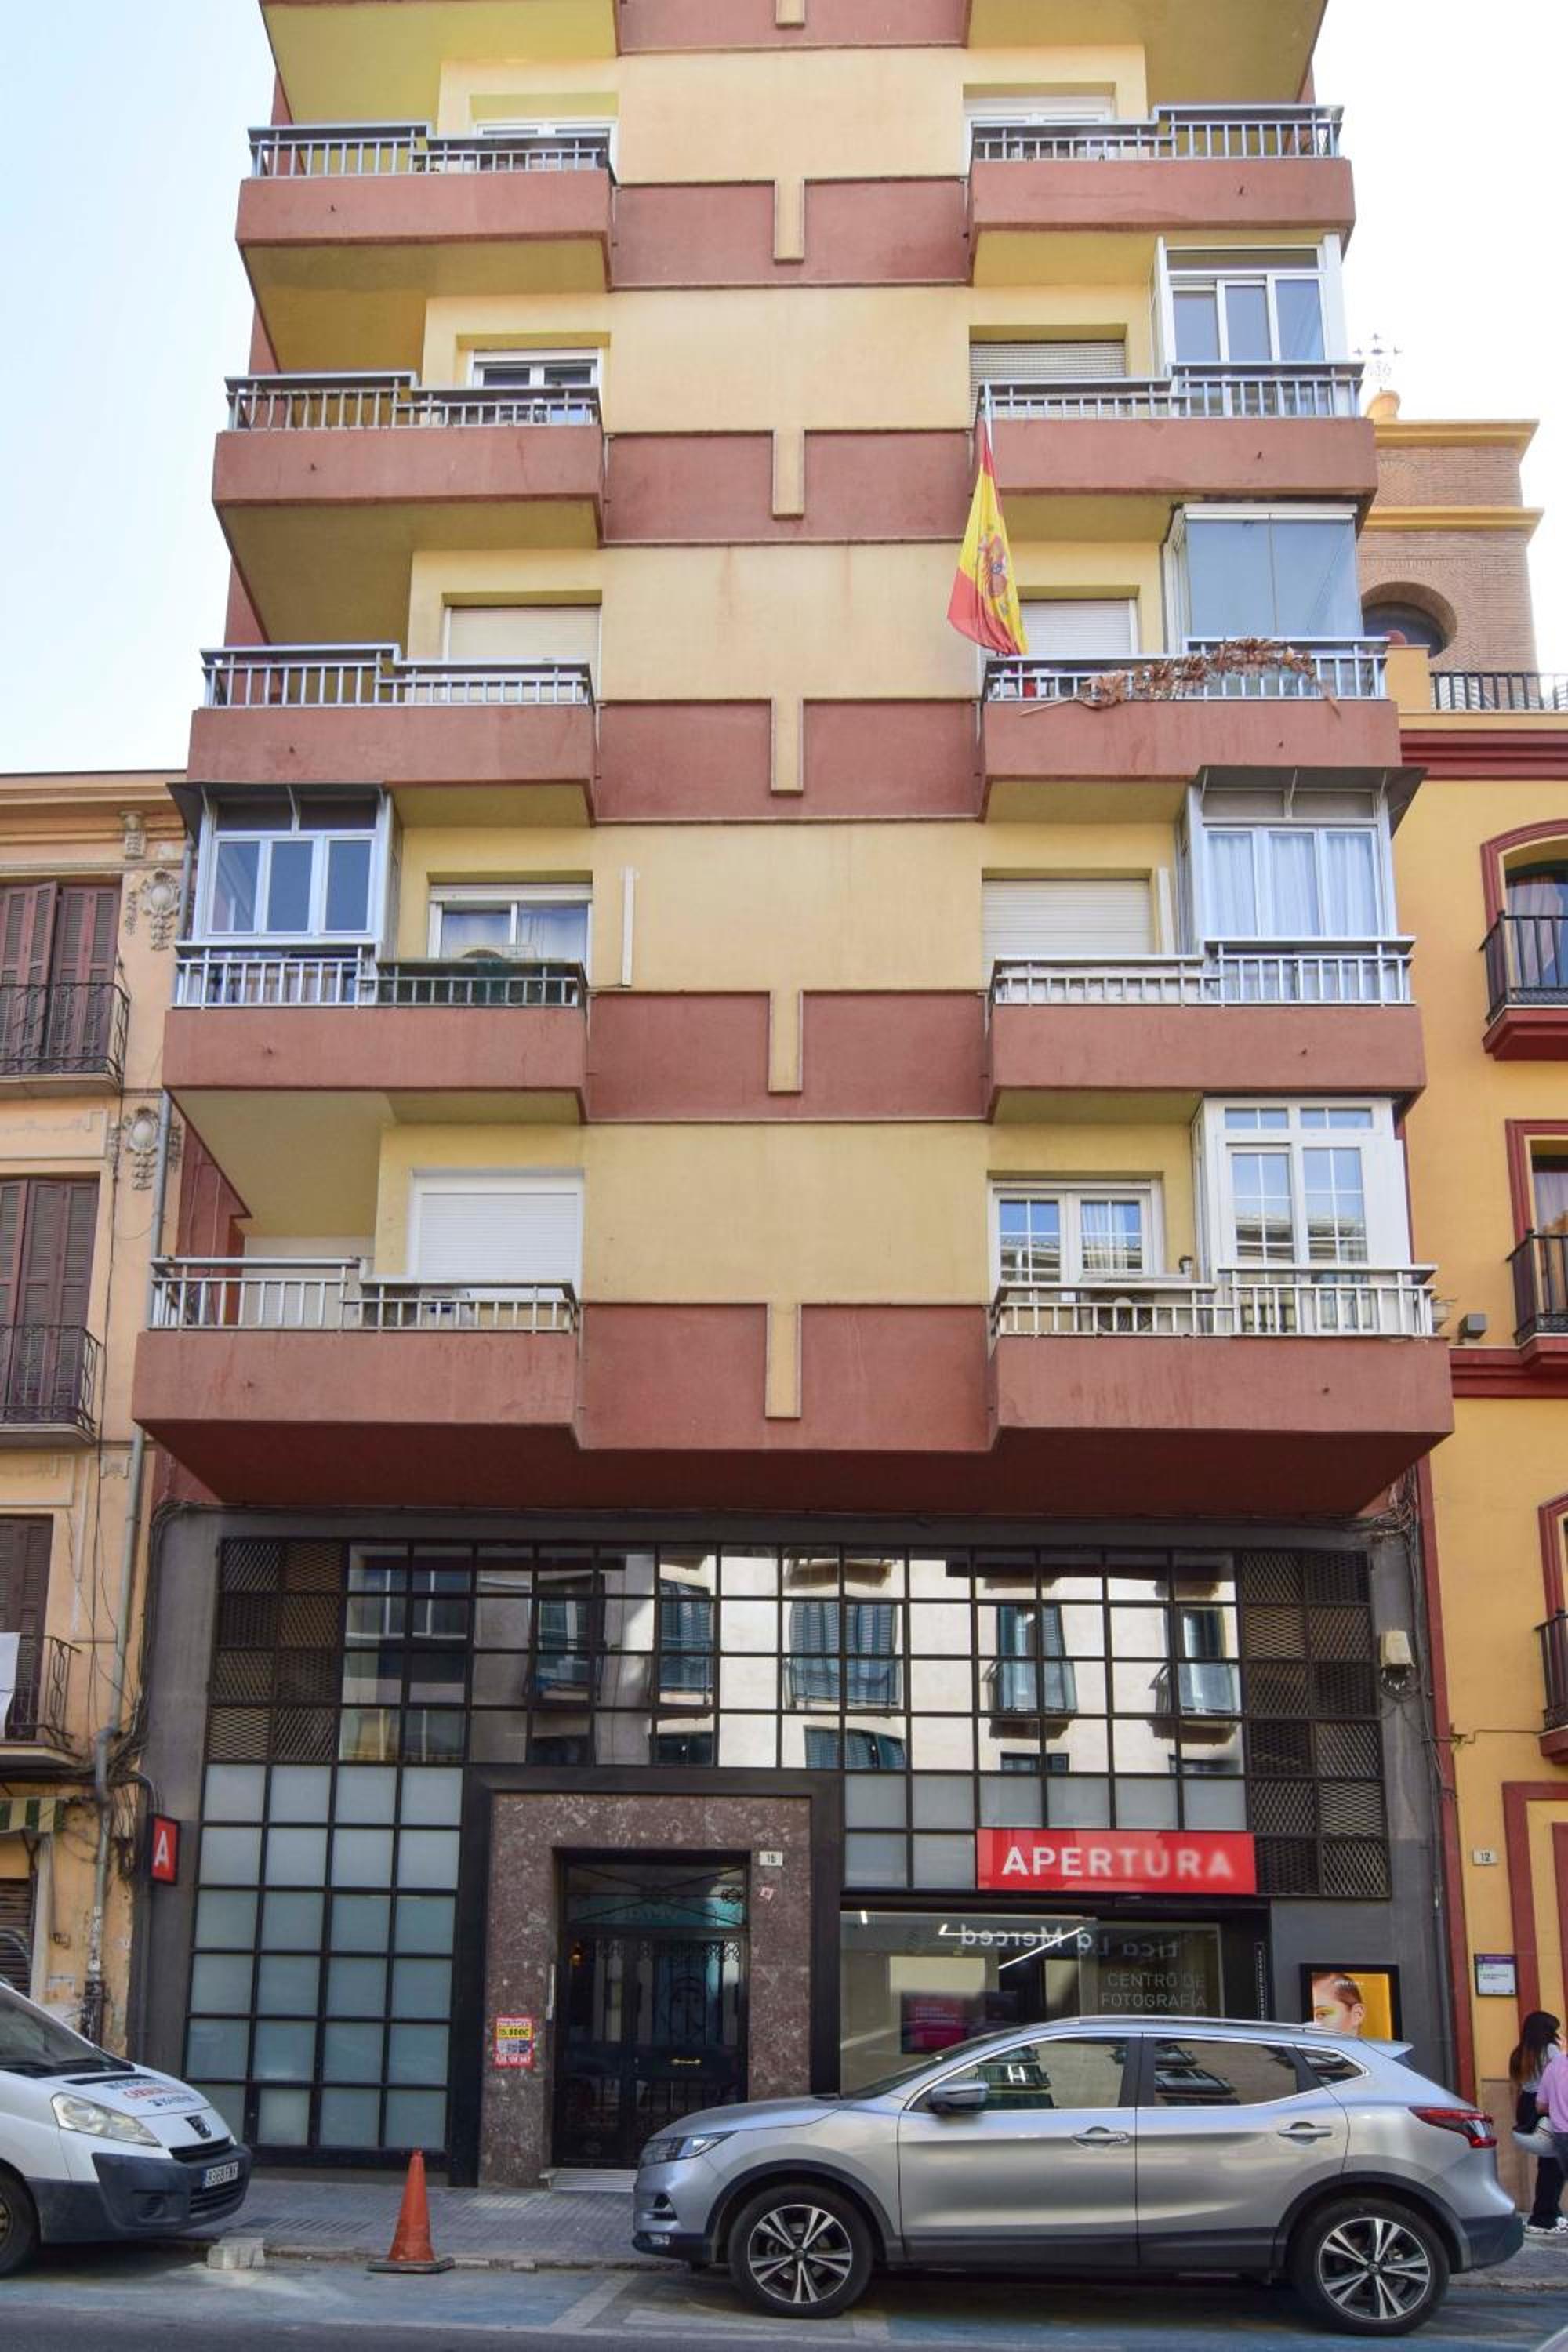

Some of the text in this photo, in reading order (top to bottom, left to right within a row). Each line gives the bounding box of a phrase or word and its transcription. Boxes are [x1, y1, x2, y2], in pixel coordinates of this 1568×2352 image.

[154, 1831, 169, 1869] A
[1001, 1846, 1235, 1878] APERTURA
[1481, 1852, 1491, 1861] 12
[1106, 1971, 1206, 1989] CENTRO DE
